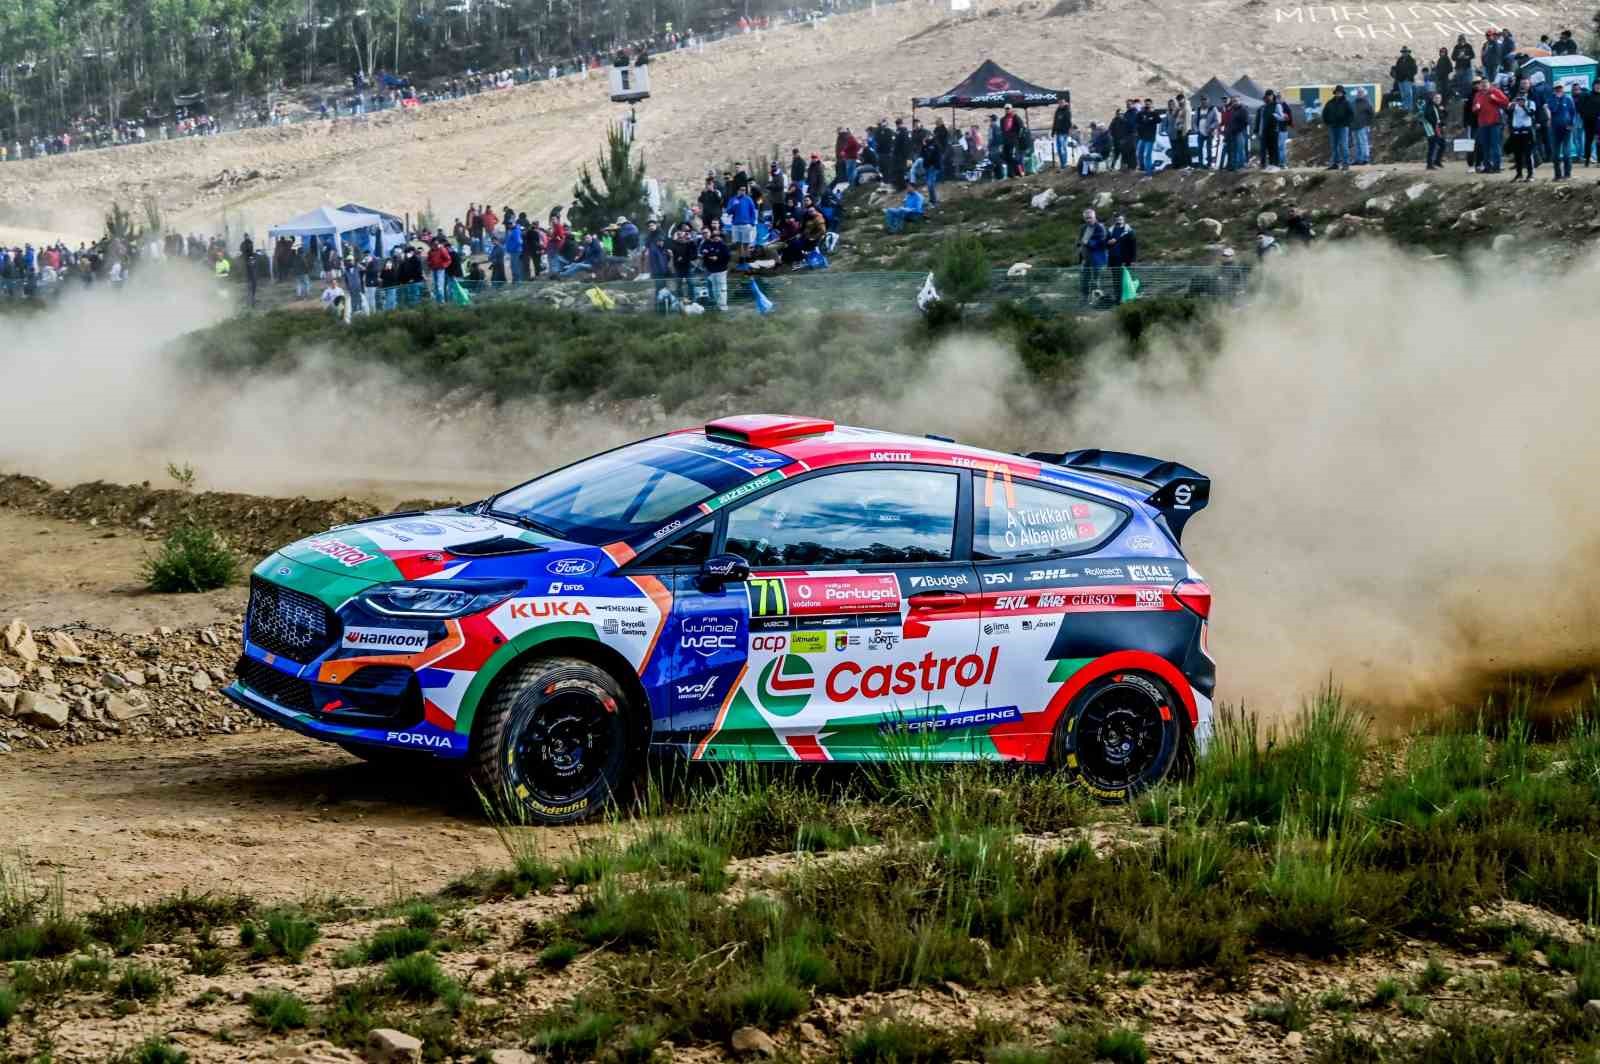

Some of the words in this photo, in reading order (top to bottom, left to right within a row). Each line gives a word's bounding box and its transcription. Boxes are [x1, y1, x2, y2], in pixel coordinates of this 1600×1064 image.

[870, 452, 912, 462] LOCTITE
[1007, 512, 1017, 528] A
[1018, 504, 1071, 526] Türkkan
[1020, 525, 1074, 547] Albayrak
[554, 559, 587, 573] Ford
[1144, 565, 1173, 577] KALE
[927, 574, 969, 588] Budget
[983, 572, 1014, 584] DSV
[1029, 568, 1073, 580] DHL
[750, 579, 785, 616] 71
[825, 587, 897, 600] Portugal
[1136, 590, 1162, 602] NGK
[993, 596, 1029, 610] SKIL
[510, 602, 591, 619] KUKA
[685, 625, 734, 633] JUNIOR
[681, 635, 737, 649] WRC
[752, 636, 787, 652] acp
[825, 646, 1000, 703] Castrol
[950, 709, 1015, 725] RACING
[386, 731, 452, 748] FORVIA
